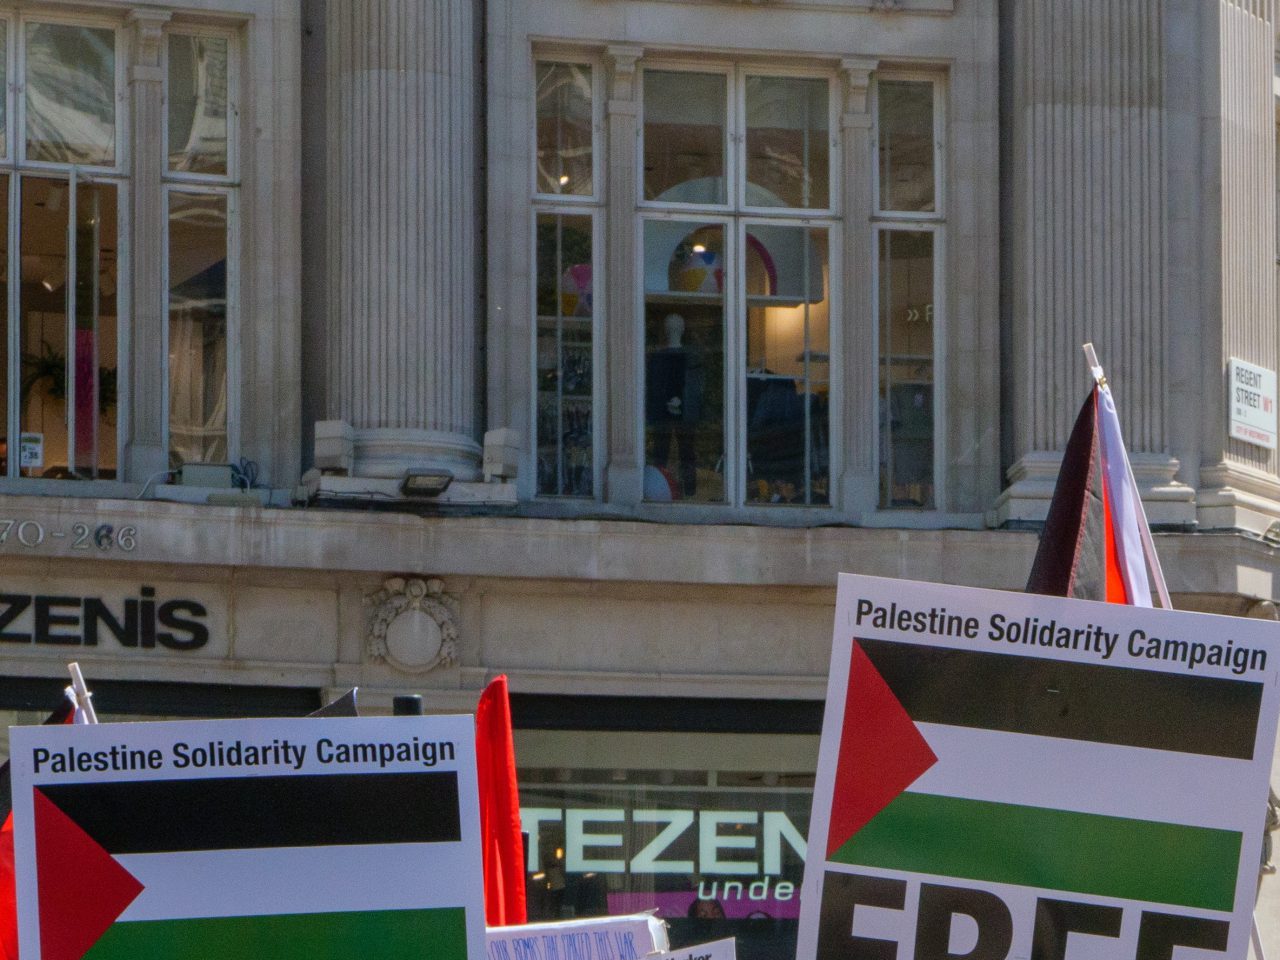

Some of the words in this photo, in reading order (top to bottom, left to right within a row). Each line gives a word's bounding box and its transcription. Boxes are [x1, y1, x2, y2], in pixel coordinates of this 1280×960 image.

[1235, 366, 1262, 390] REGENT
[1235, 387, 1261, 409] STREET
[856, 599, 979, 639] Palestine
[988, 614, 1119, 659] Solidarity
[1127, 630, 1268, 674] Campaign
[33, 743, 163, 774] Palestine
[172, 739, 306, 770] Solidarity
[316, 736, 456, 768] Campaign
[698, 876, 794, 901] unde
